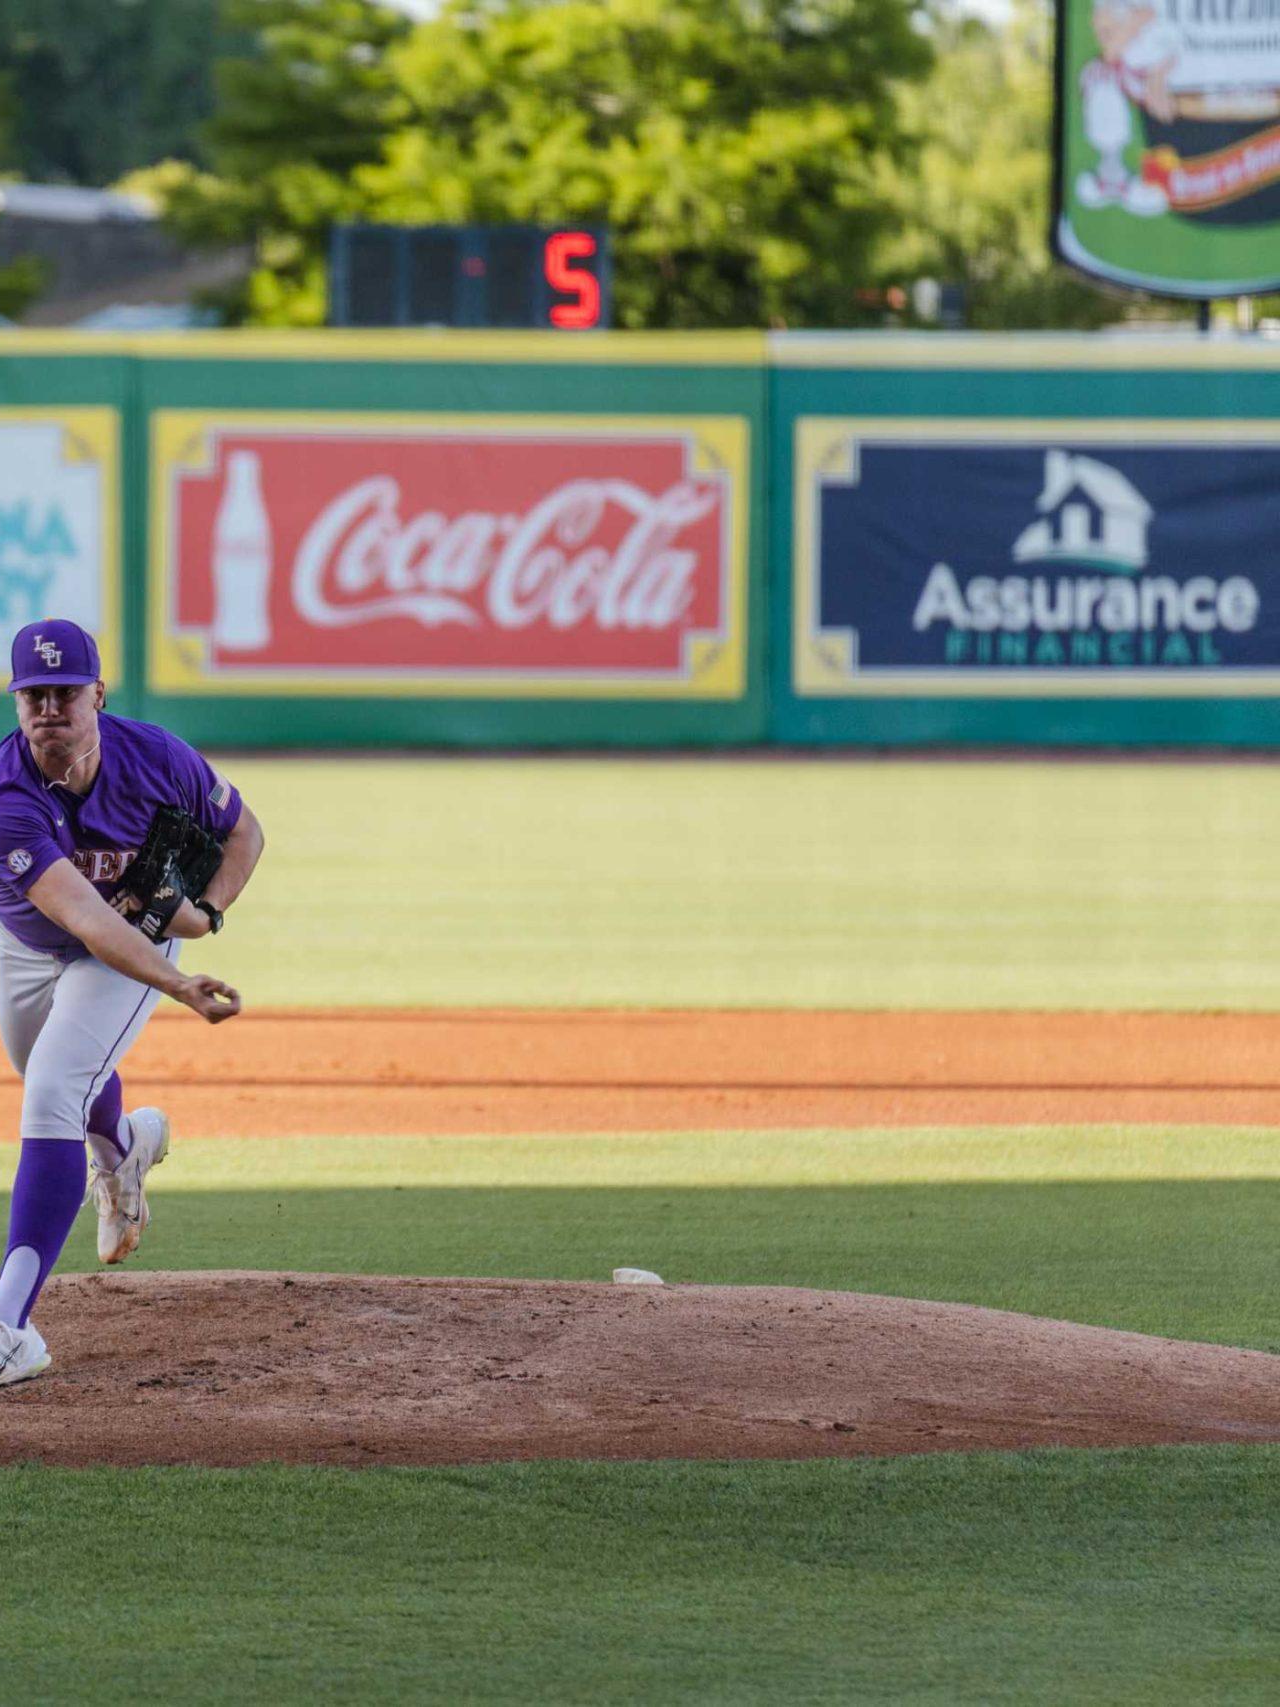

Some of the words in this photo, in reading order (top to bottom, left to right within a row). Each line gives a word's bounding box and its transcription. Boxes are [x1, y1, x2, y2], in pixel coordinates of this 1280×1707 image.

[544, 232, 600, 330] 5
[912, 561, 1261, 633] Assurance
[33, 634, 63, 668] LSU
[943, 629, 1221, 665] FINANCIAL
